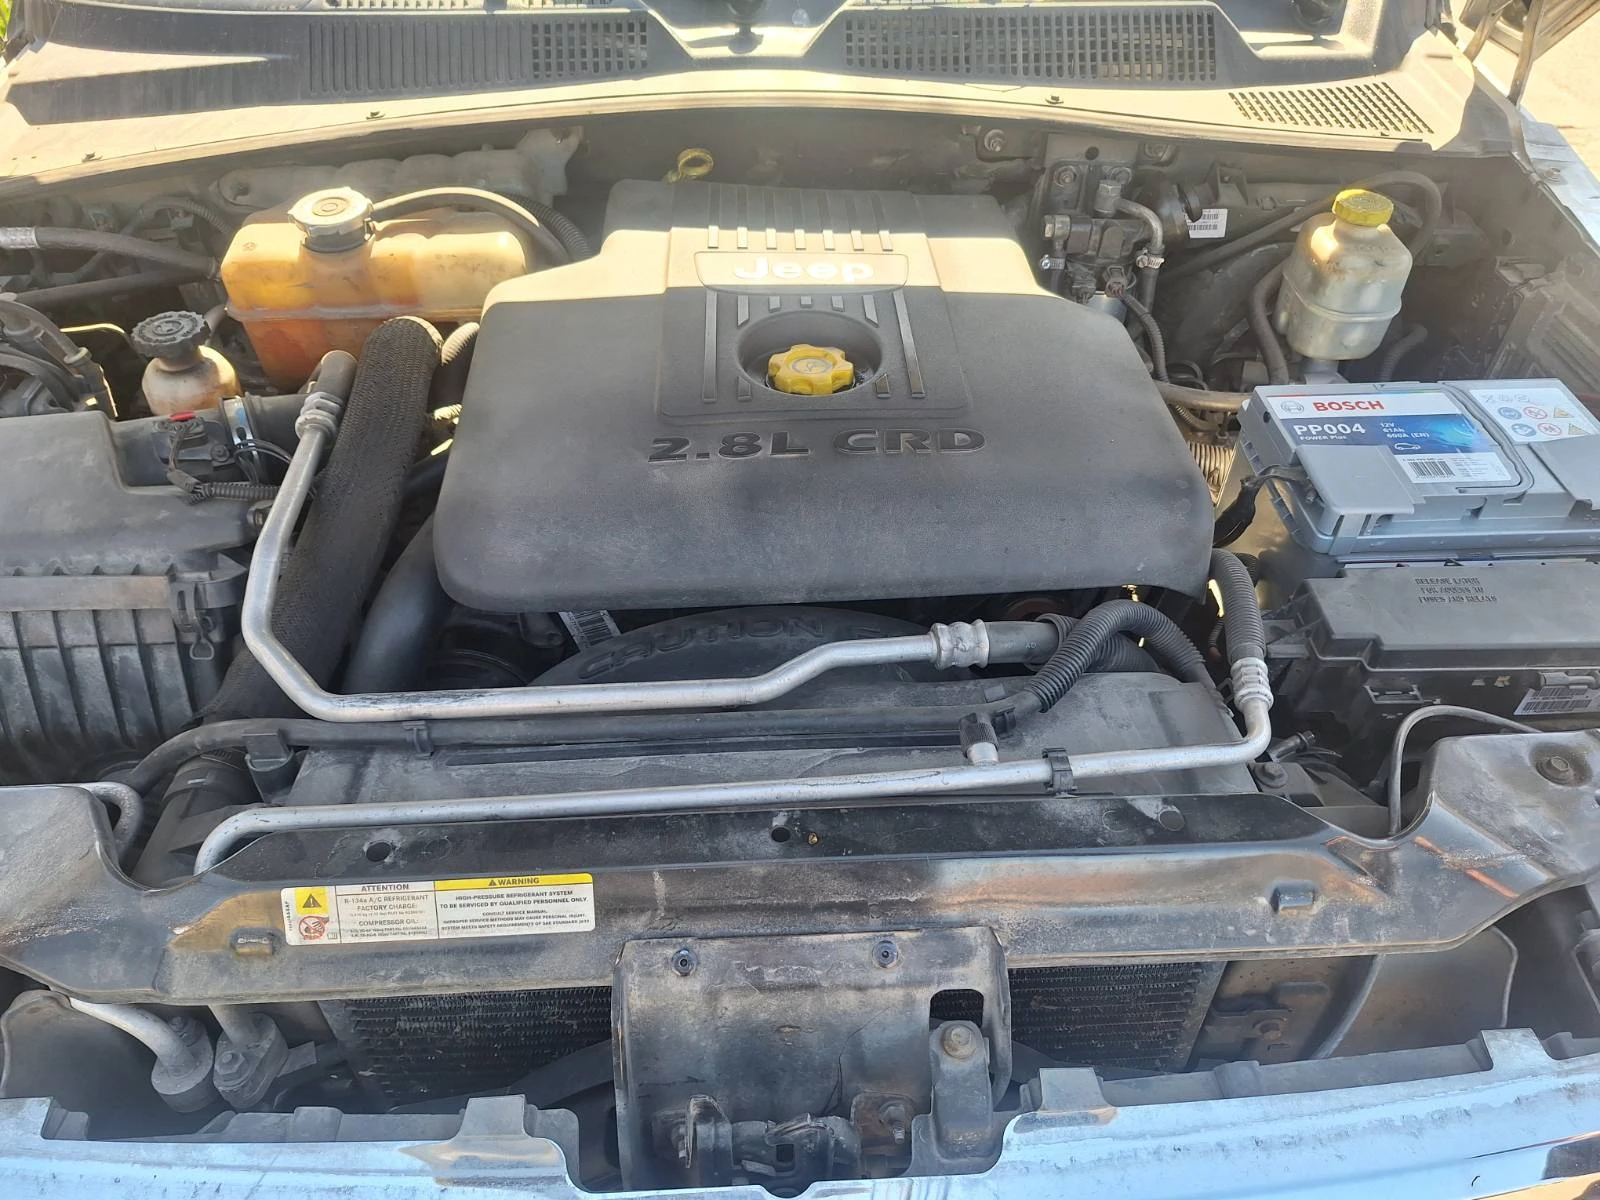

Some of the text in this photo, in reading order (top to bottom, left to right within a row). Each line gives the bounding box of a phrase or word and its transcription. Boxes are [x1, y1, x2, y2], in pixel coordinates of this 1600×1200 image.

[733, 256, 875, 284] Jeep
[1313, 401, 1384, 412] BOSCH
[1293, 423, 1366, 436] PP004
[648, 427, 986, 463] 2.8L CRD
[577, 615, 825, 680] CAUTION
[498, 877, 540, 886] WARNING
[361, 883, 410, 892] ATTENTION
[344, 896, 368, 904] R-134a
[383, 894, 429, 902] REFRIGERANT
[455, 893, 505, 901] HIGH-PRESSURE
[358, 919, 405, 927] COMPRESSOR
